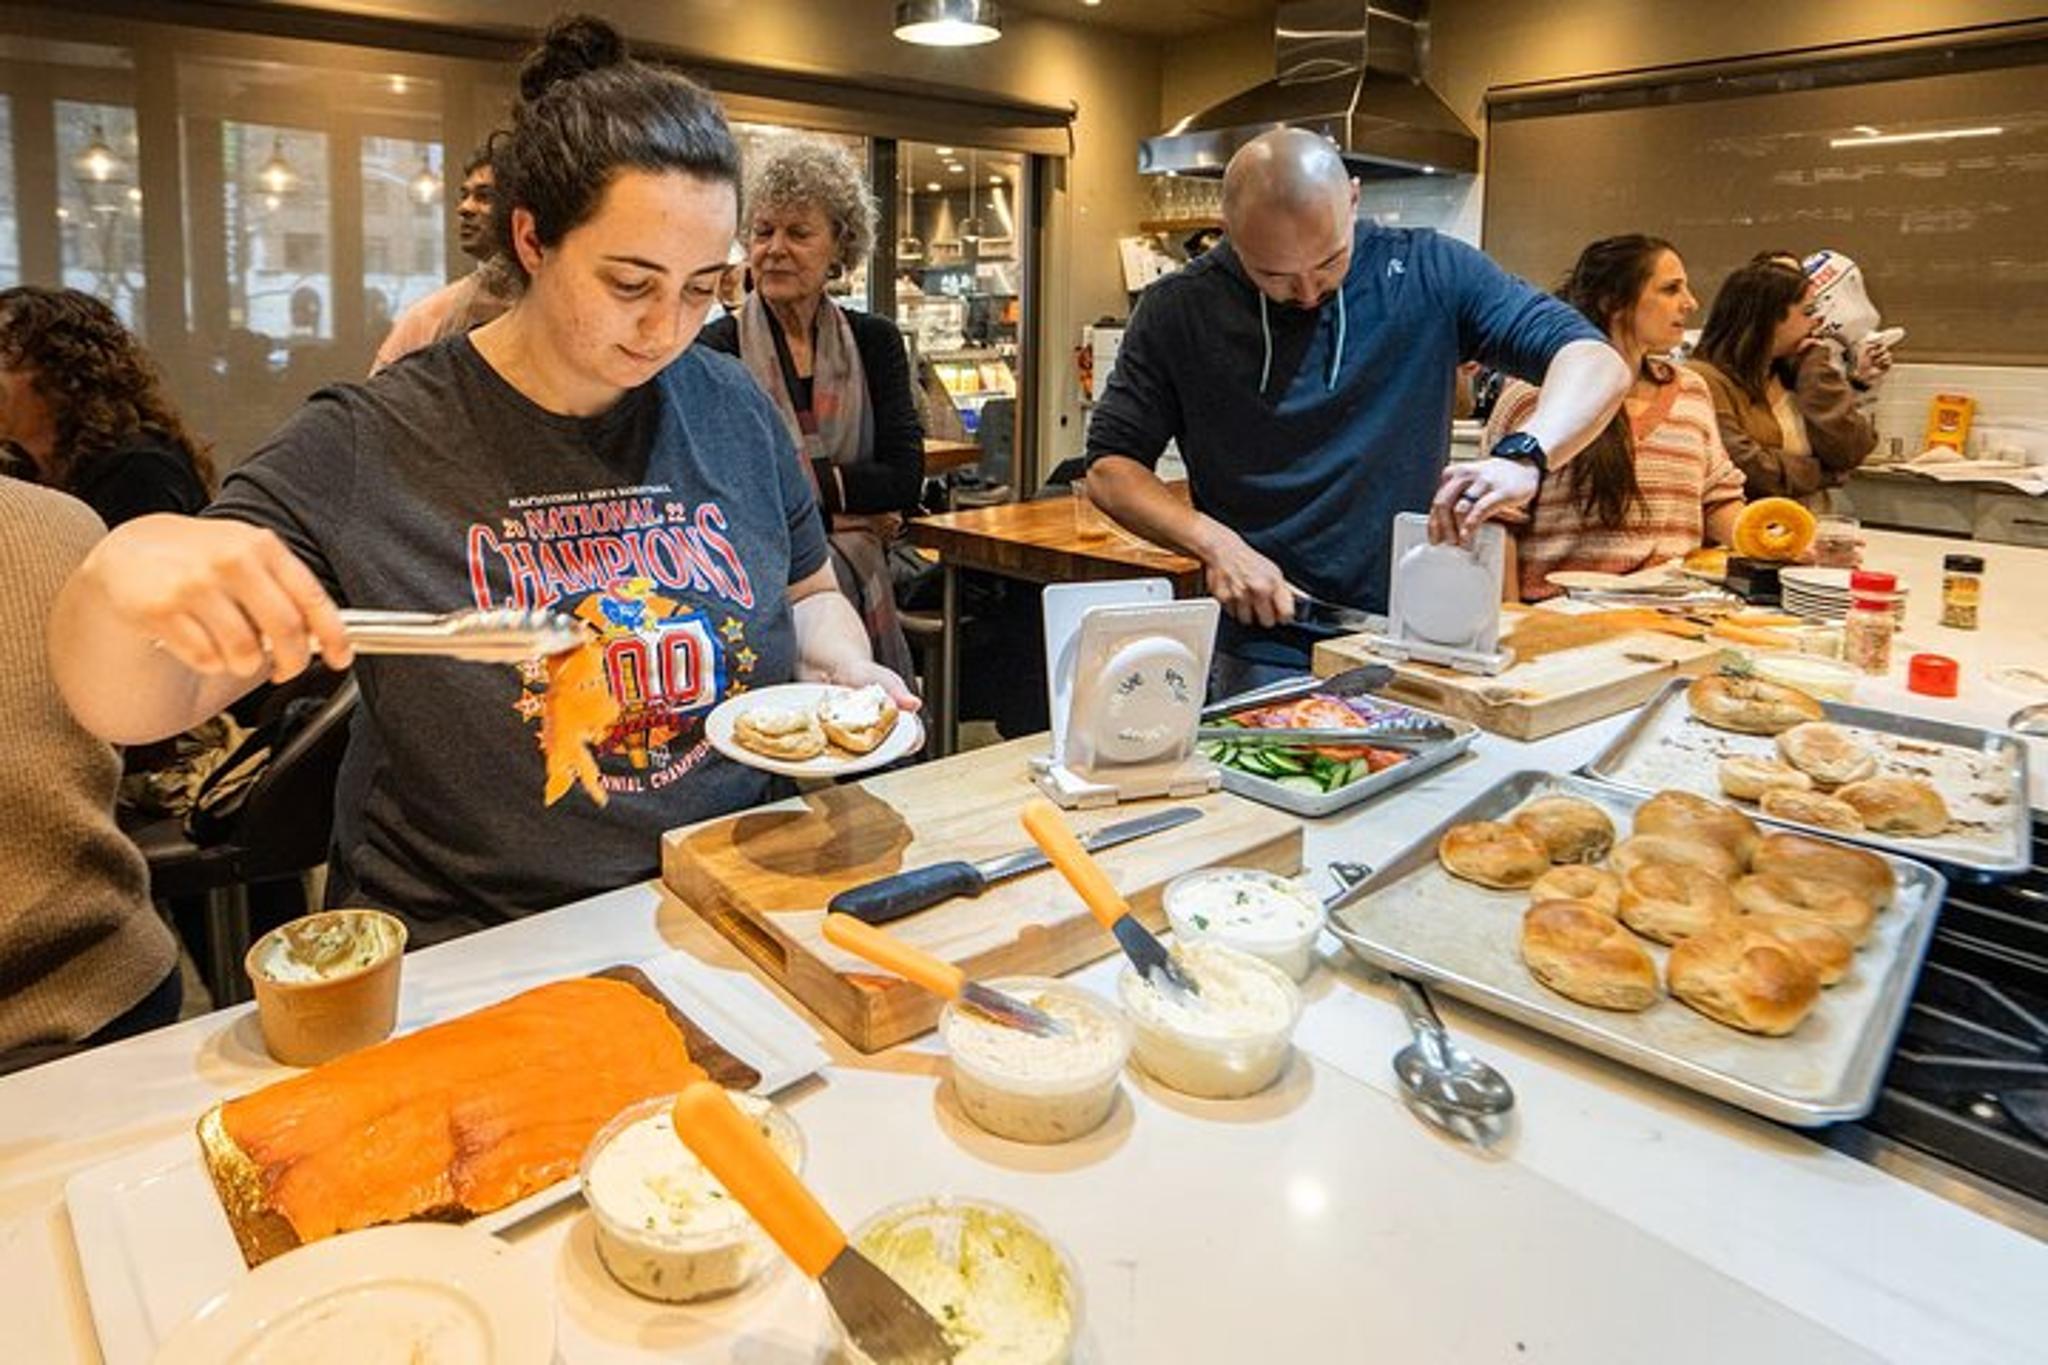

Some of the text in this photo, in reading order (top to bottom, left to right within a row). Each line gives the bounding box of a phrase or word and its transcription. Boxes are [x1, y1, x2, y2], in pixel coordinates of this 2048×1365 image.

[523, 498, 665, 540] NATIONAL
[665, 502, 687, 523] 22
[468, 503, 755, 611] CHAMPIONS
